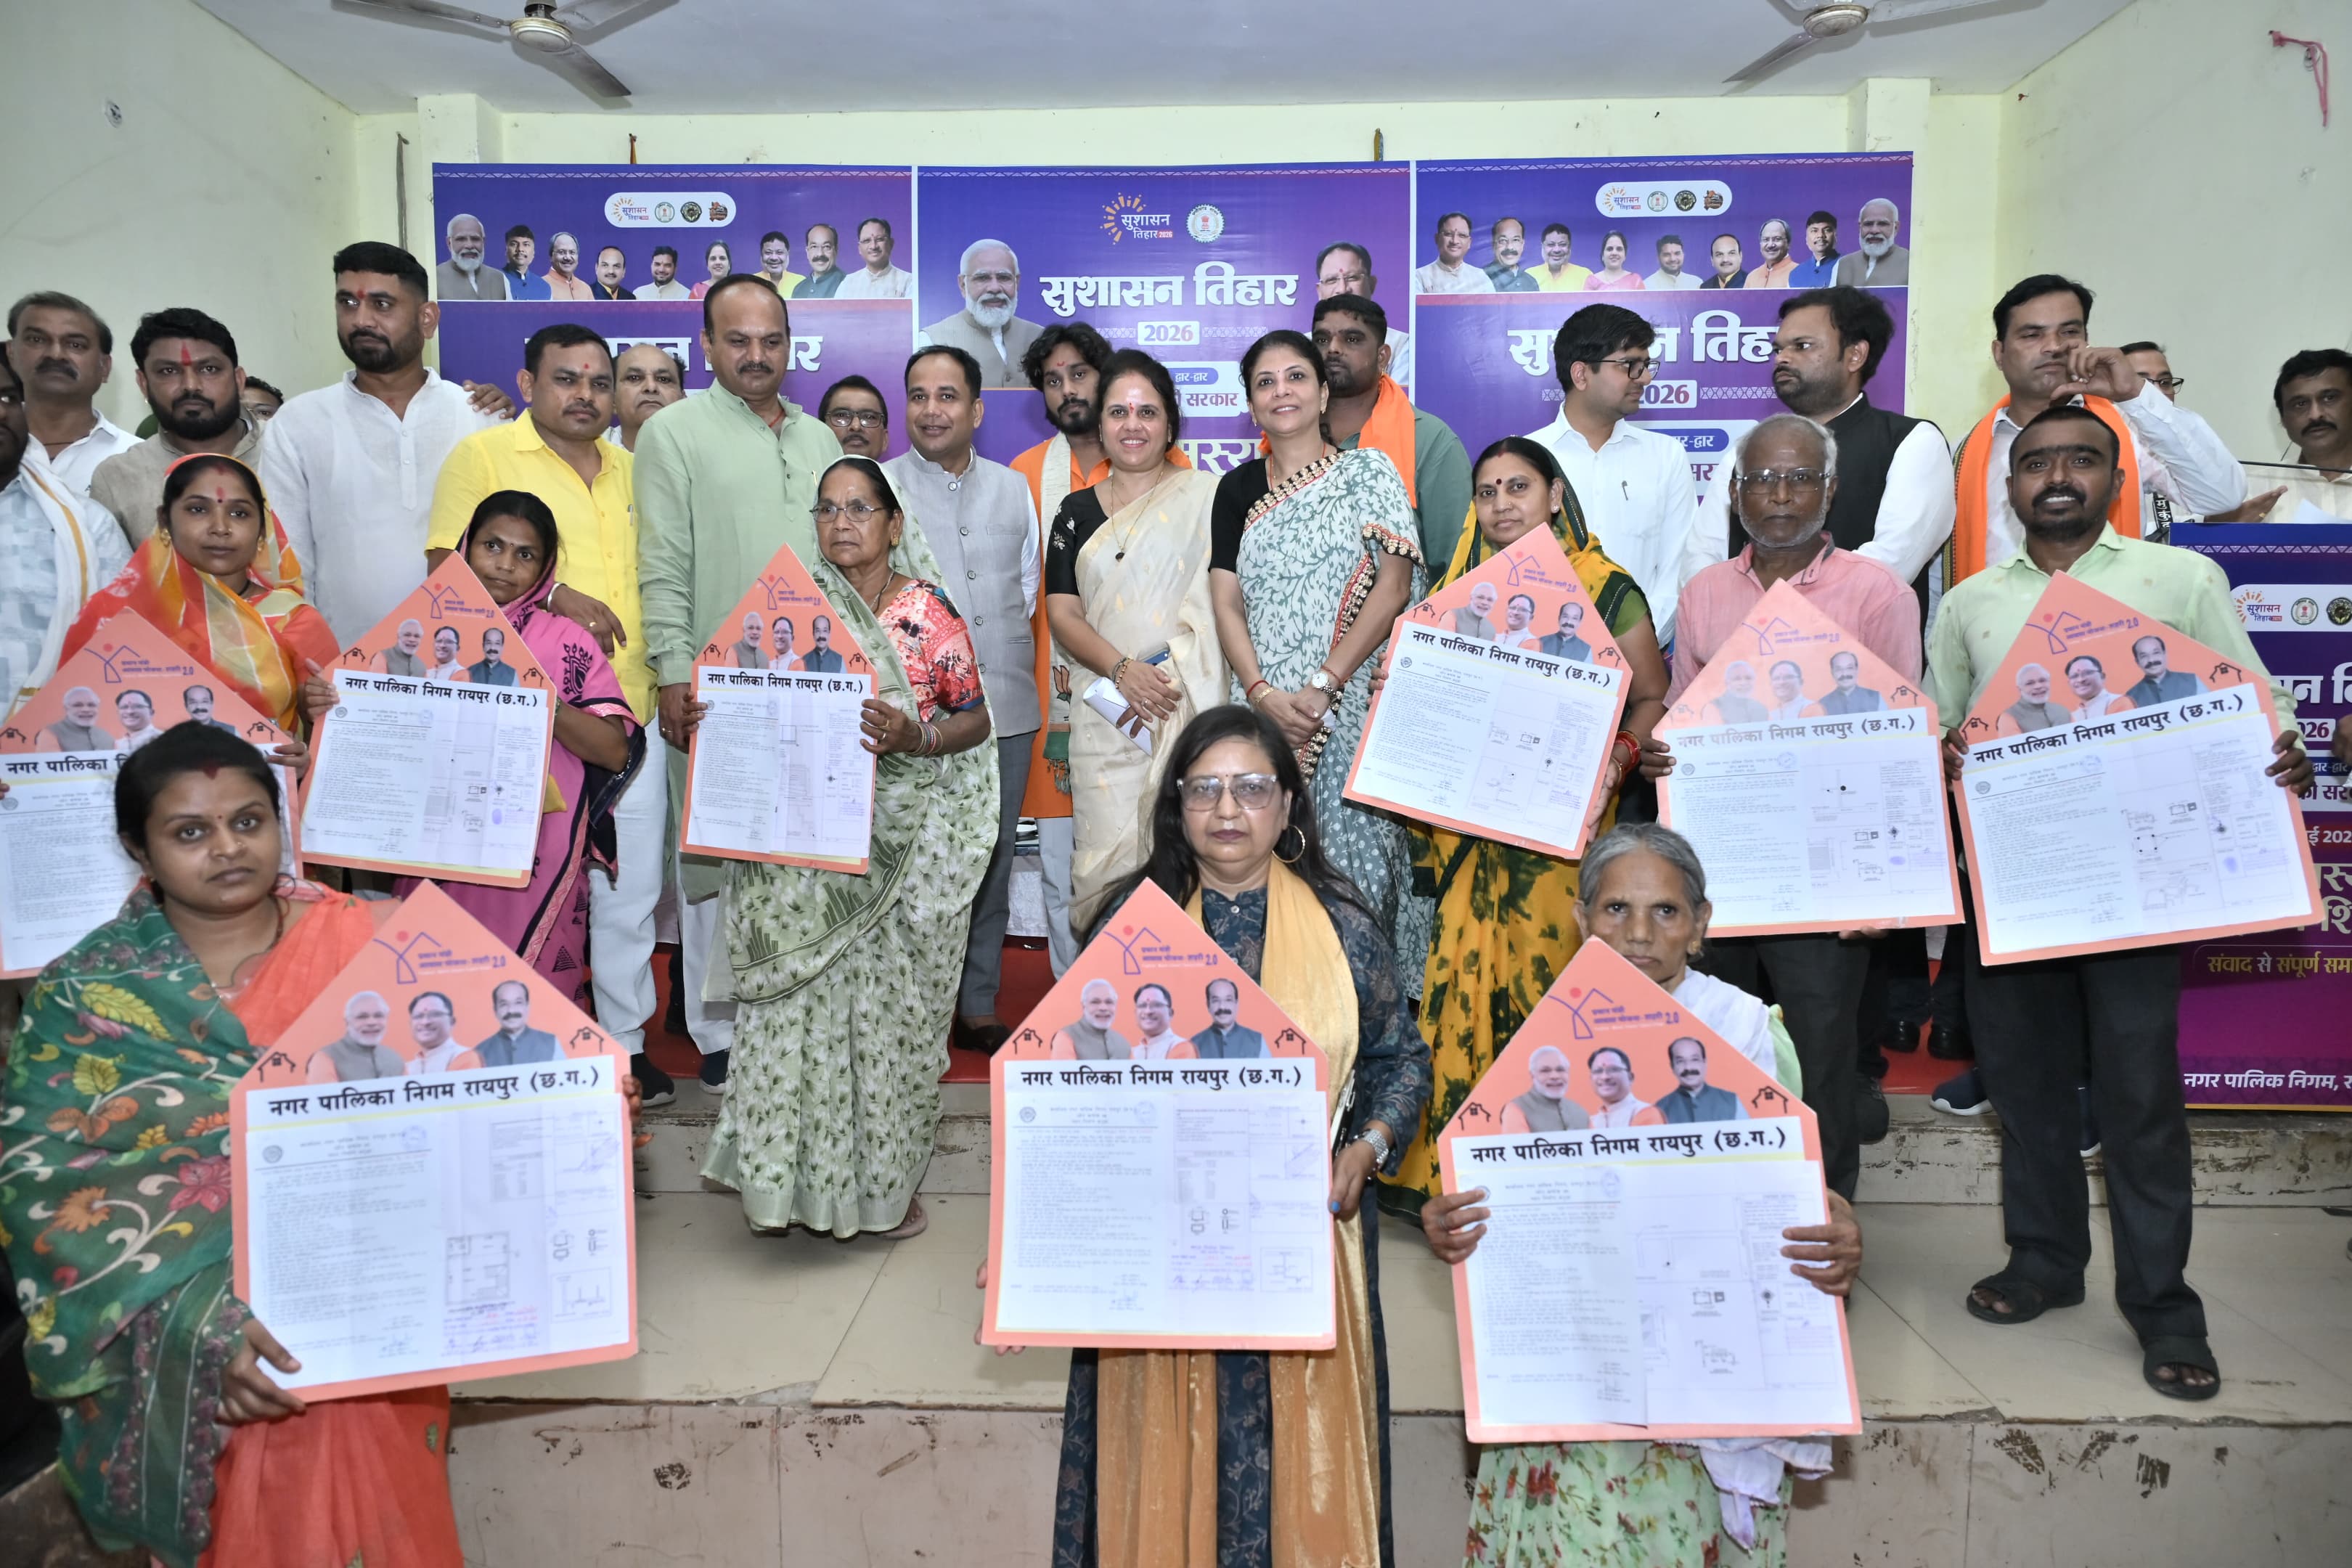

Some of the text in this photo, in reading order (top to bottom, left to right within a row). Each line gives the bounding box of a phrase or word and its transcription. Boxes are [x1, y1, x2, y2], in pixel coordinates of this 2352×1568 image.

[1121, 214, 1171, 230] सुशासन
[1133, 227, 1158, 239] तिहार
[1040, 261, 1299, 317] सुशासन तिहार
[1143, 324, 1194, 342] 2026
[1175, 372, 1209, 382] द्वार-द्वार
[1185, 393, 1239, 407] सरकार
[1638, 385, 1690, 404] 026
[2247, 604, 2281, 616] सुशासन
[1413, 631, 1609, 687] नगर पालिका निगम रायपुर (छ.ग.)
[346, 678, 368, 690] नगर
[373, 676, 418, 694] पालिका
[422, 682, 452, 698] निगम
[497, 692, 536, 706] (छ.ग.)
[708, 674, 725, 684] नगर
[729, 671, 763, 686] पालिका
[767, 673, 791, 687] निगम
[828, 679, 862, 693] (छ.ग.)
[1678, 715, 1914, 747] नगर पालिका निगम रायपुर (छ.ग.)
[1974, 691, 2242, 762] नगर पालिका निगम रायपुर (छ.ग.)
[6, 762, 38, 774] नगर
[46, 756, 107, 772] पालिका
[2207, 953, 2253, 973] संवाद
[2256, 952, 2272, 973] से
[2276, 951, 2322, 977] संपूर्ण
[1021, 1065, 1301, 1090] नगर पालिका निगम रायपुर (छ.ग.)
[2184, 1074, 2221, 1087] नगर
[2224, 1069, 2285, 1088] पालिक
[2288, 1070, 2340, 1091] निगम,
[269, 1066, 598, 1115] नगर पालिका निगम रायपुर (छ.ग.)
[1471, 1127, 1785, 1161] नगर पालिका निगम रायपुर (छ.ग.)
